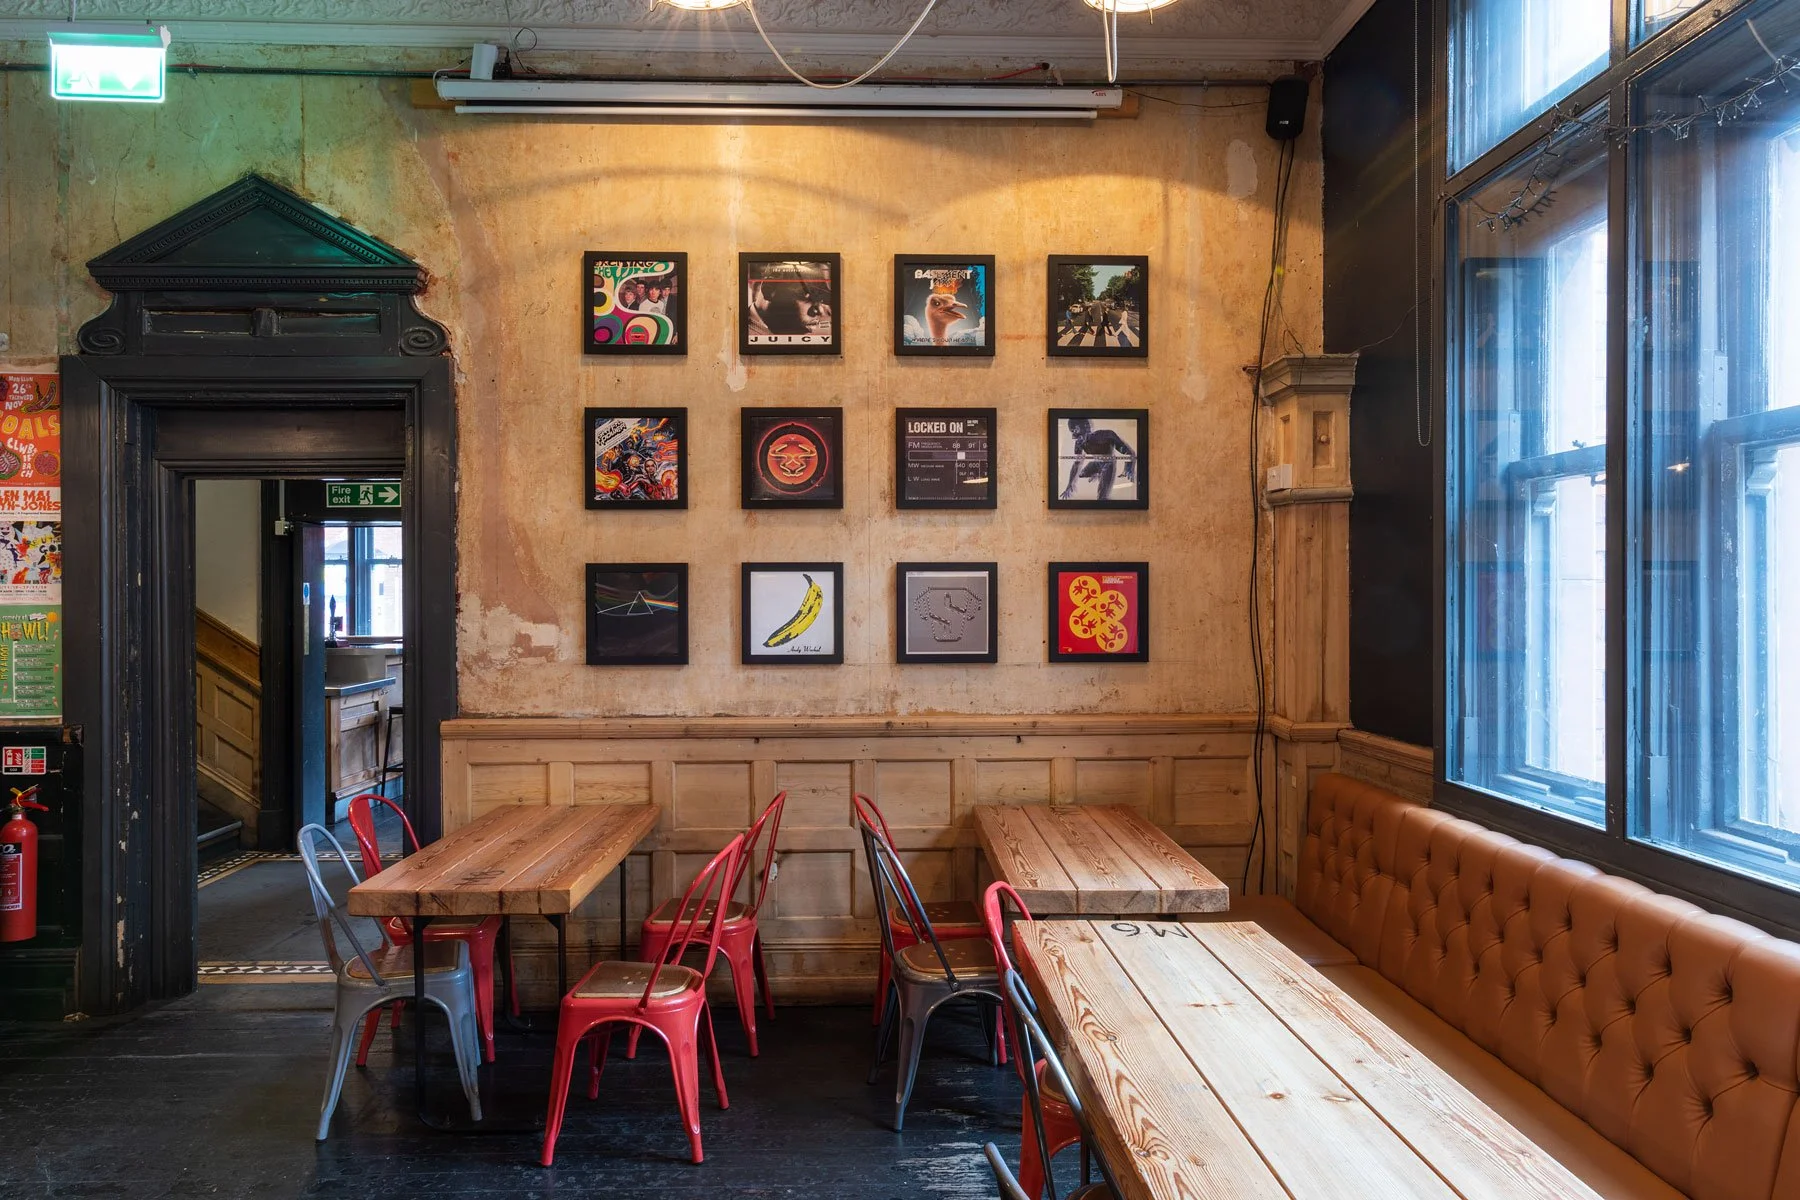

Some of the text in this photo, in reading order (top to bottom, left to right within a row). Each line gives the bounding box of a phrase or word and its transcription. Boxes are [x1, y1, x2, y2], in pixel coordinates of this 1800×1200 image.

[914, 269, 973, 279] BASEMENT
[5, 400, 24, 410] NOV
[0, 410, 60, 438] OALS
[908, 422, 946, 433] LOCKED
[949, 422, 963, 433] ON
[908, 441, 920, 449] FM
[331, 486, 352, 494] Fire
[332, 495, 351, 504] exit
